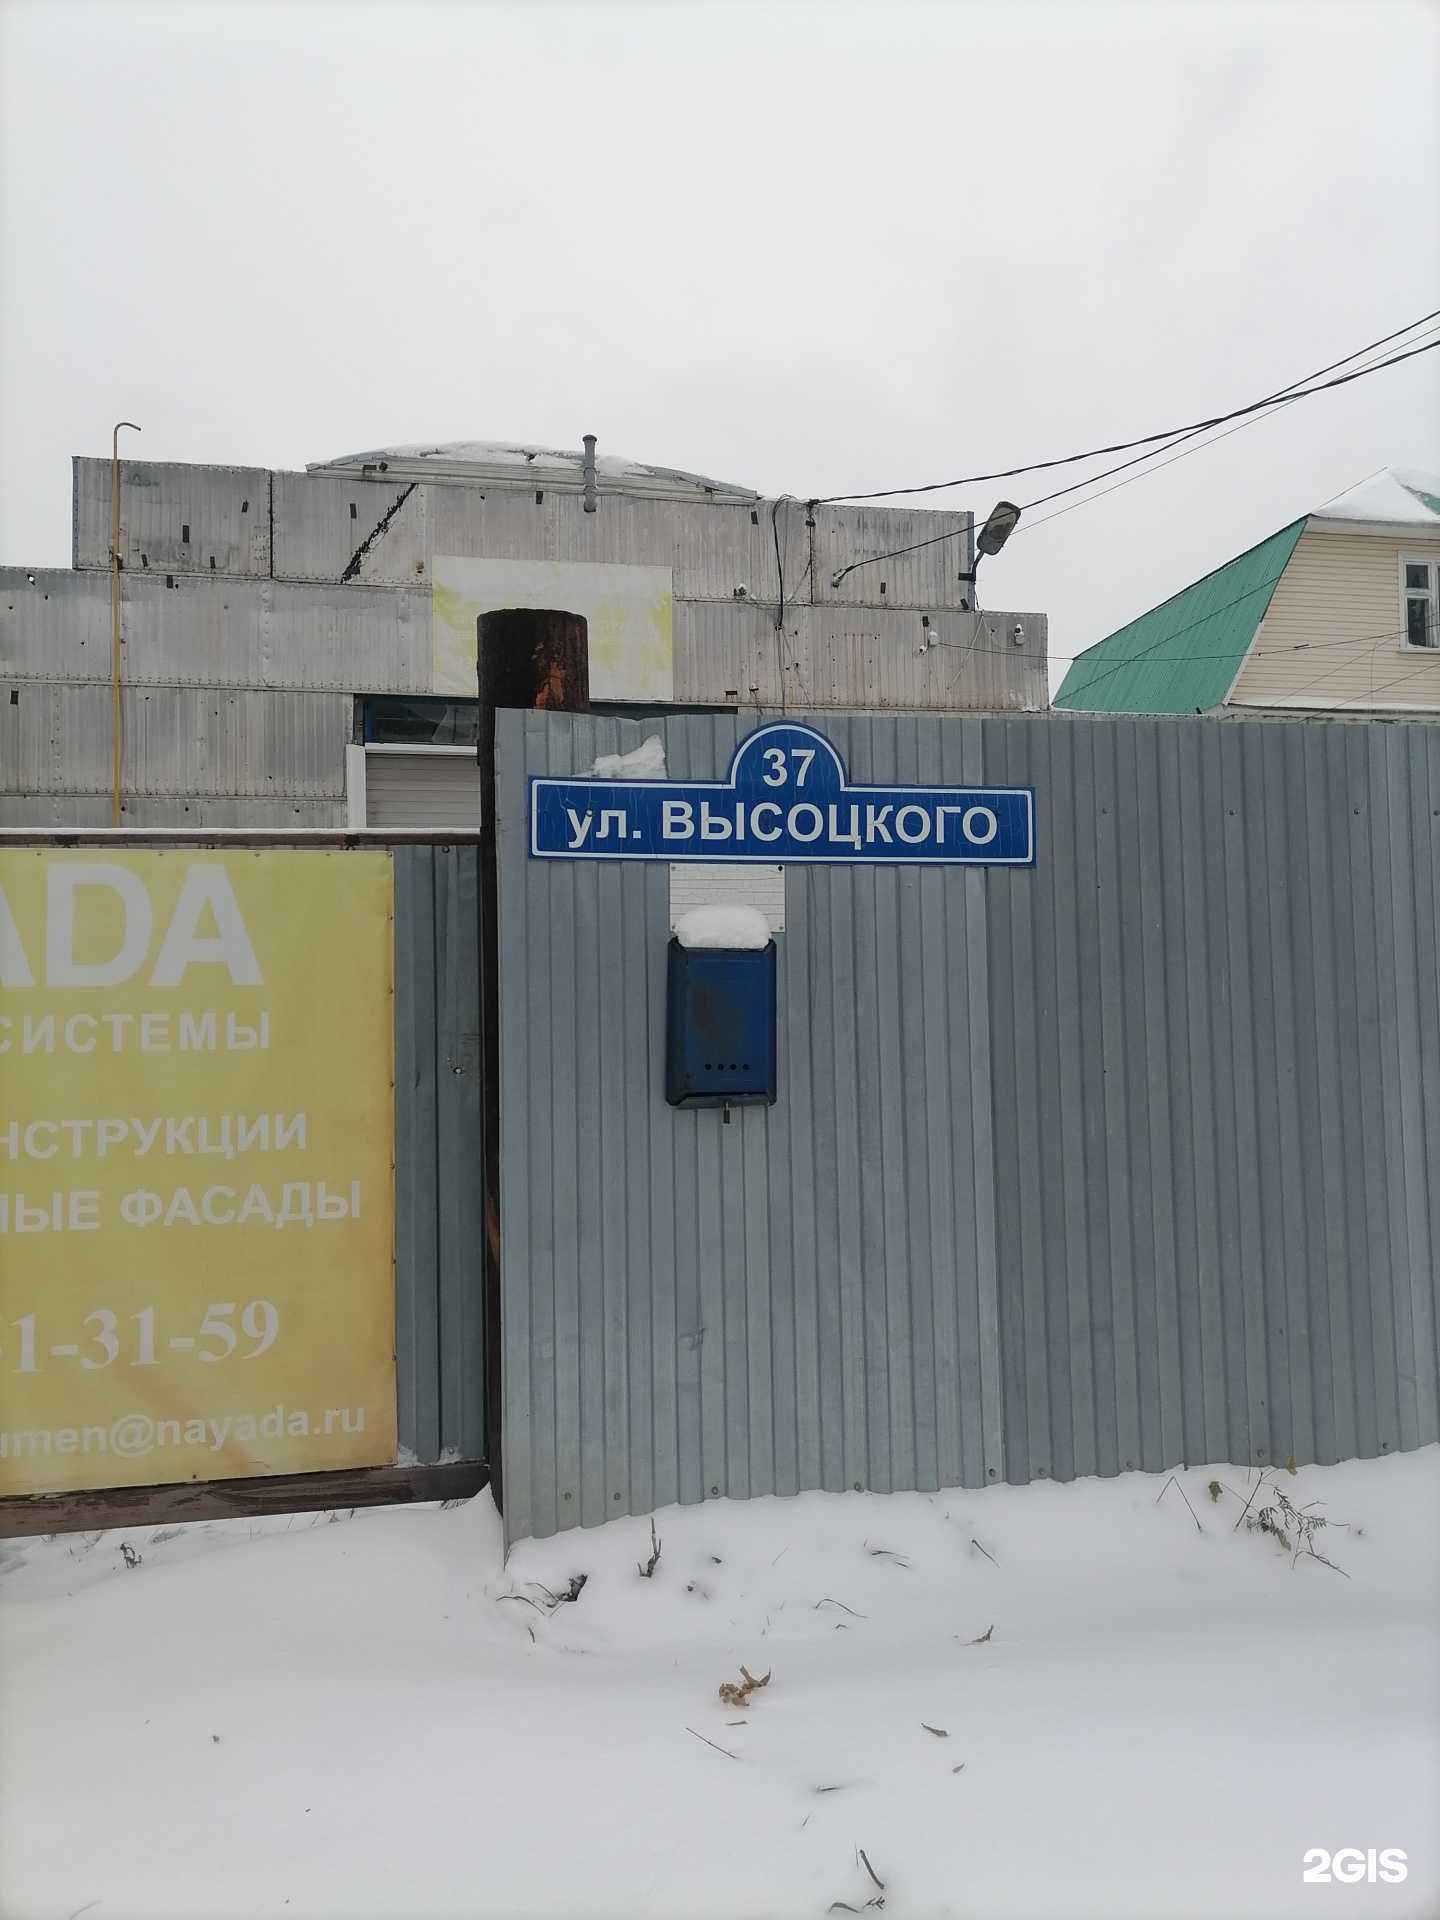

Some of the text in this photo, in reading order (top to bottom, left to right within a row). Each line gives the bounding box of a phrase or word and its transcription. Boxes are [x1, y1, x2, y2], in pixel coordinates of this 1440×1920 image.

[762, 748, 816, 787] 37
[567, 801, 998, 851] ул. ВЫСОЦКОГО
[0, 1180, 362, 1233] ЫЕ ФАСАДЫ
[0, 1299, 280, 1374] 1-31-59
